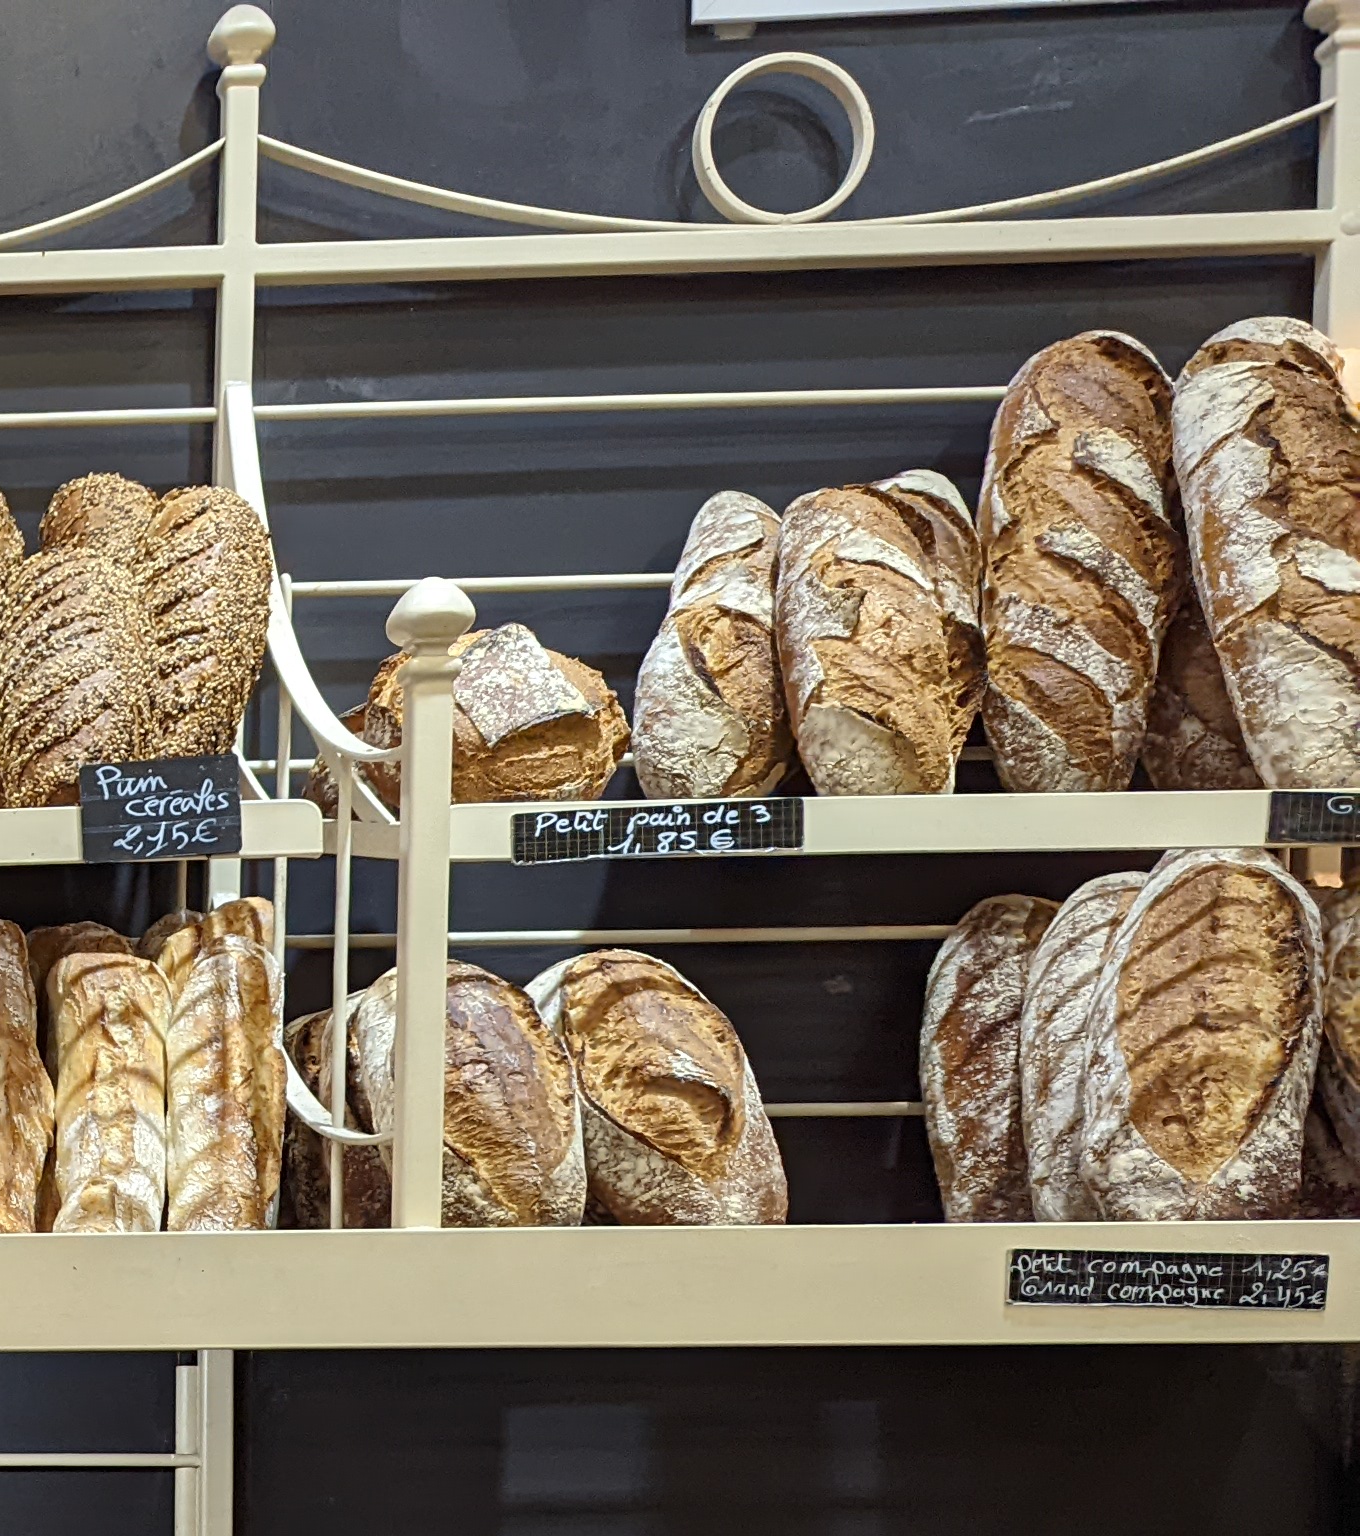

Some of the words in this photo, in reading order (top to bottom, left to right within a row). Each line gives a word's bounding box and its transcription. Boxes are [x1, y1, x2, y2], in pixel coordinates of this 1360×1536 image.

[95, 765, 168, 800] Pain
[534, 811, 609, 837] Petit
[627, 805, 691, 834] pain
[703, 804, 741, 825] de
[750, 804, 771, 824] 3
[710, 829, 735, 849] €
